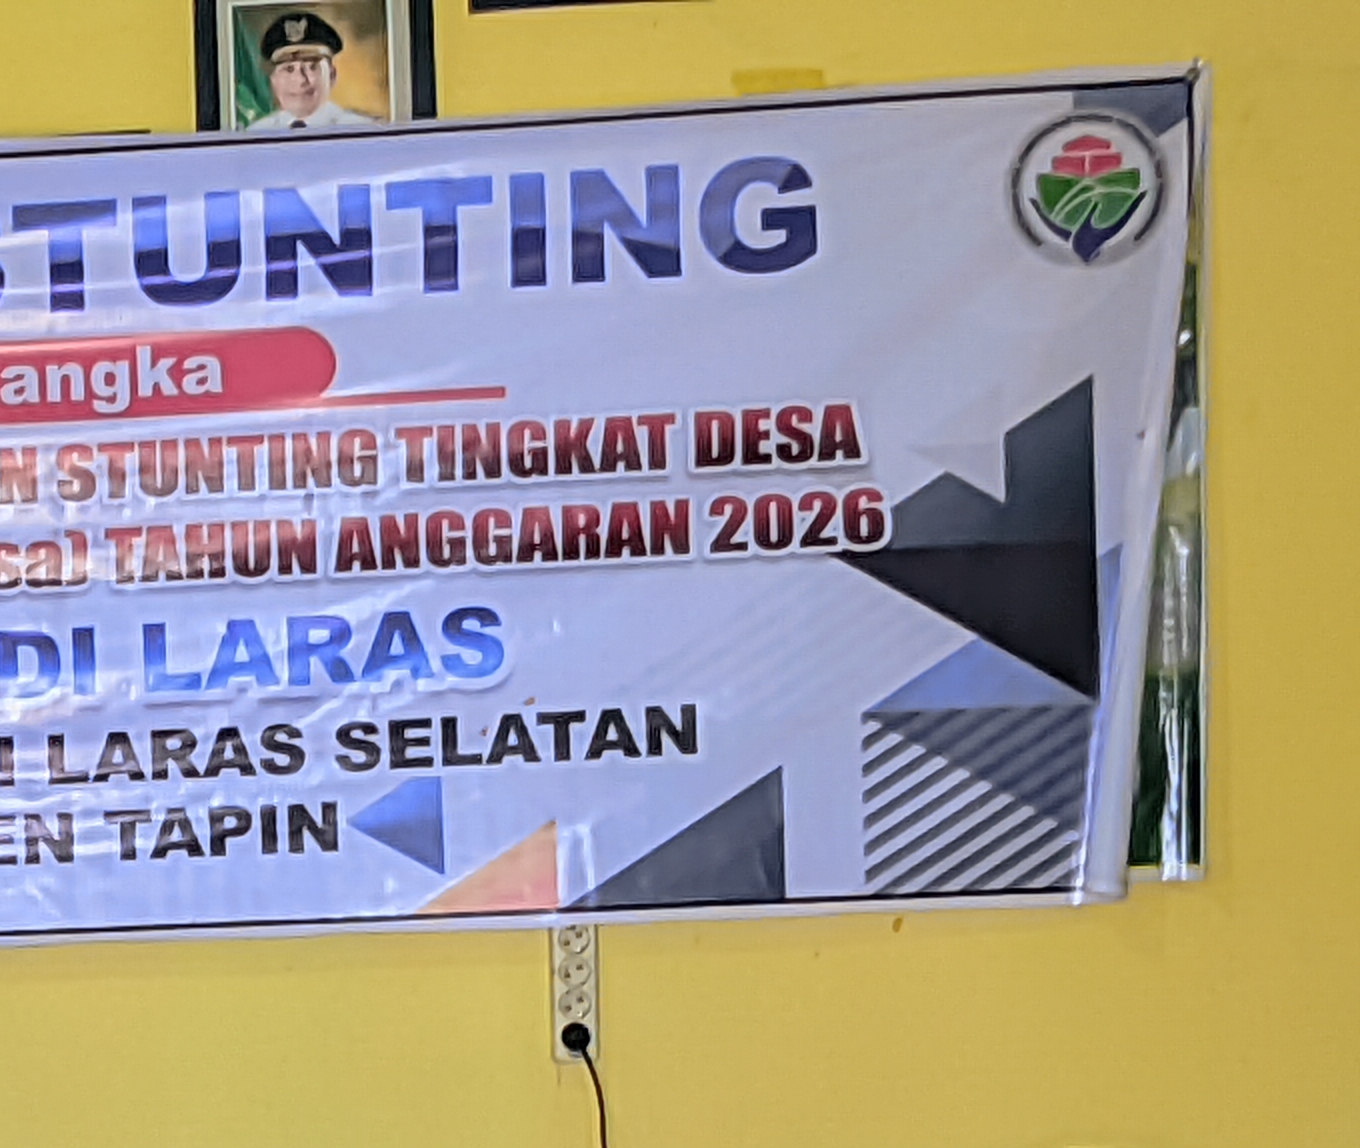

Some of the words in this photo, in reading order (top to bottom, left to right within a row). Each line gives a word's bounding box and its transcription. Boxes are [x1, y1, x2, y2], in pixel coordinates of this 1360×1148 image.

[57, 429, 378, 502] STUNTING
[396, 412, 675, 482] TINGKAT
[693, 403, 861, 468] DESA
[105, 518, 317, 583] TAHUN
[333, 499, 691, 572] ANGGARAN
[708, 488, 886, 554] 2026
[143, 607, 505, 692] LARAS
[46, 723, 305, 784] LARAS
[334, 704, 699, 772] SELATAN
[104, 801, 340, 861] TAPIN
